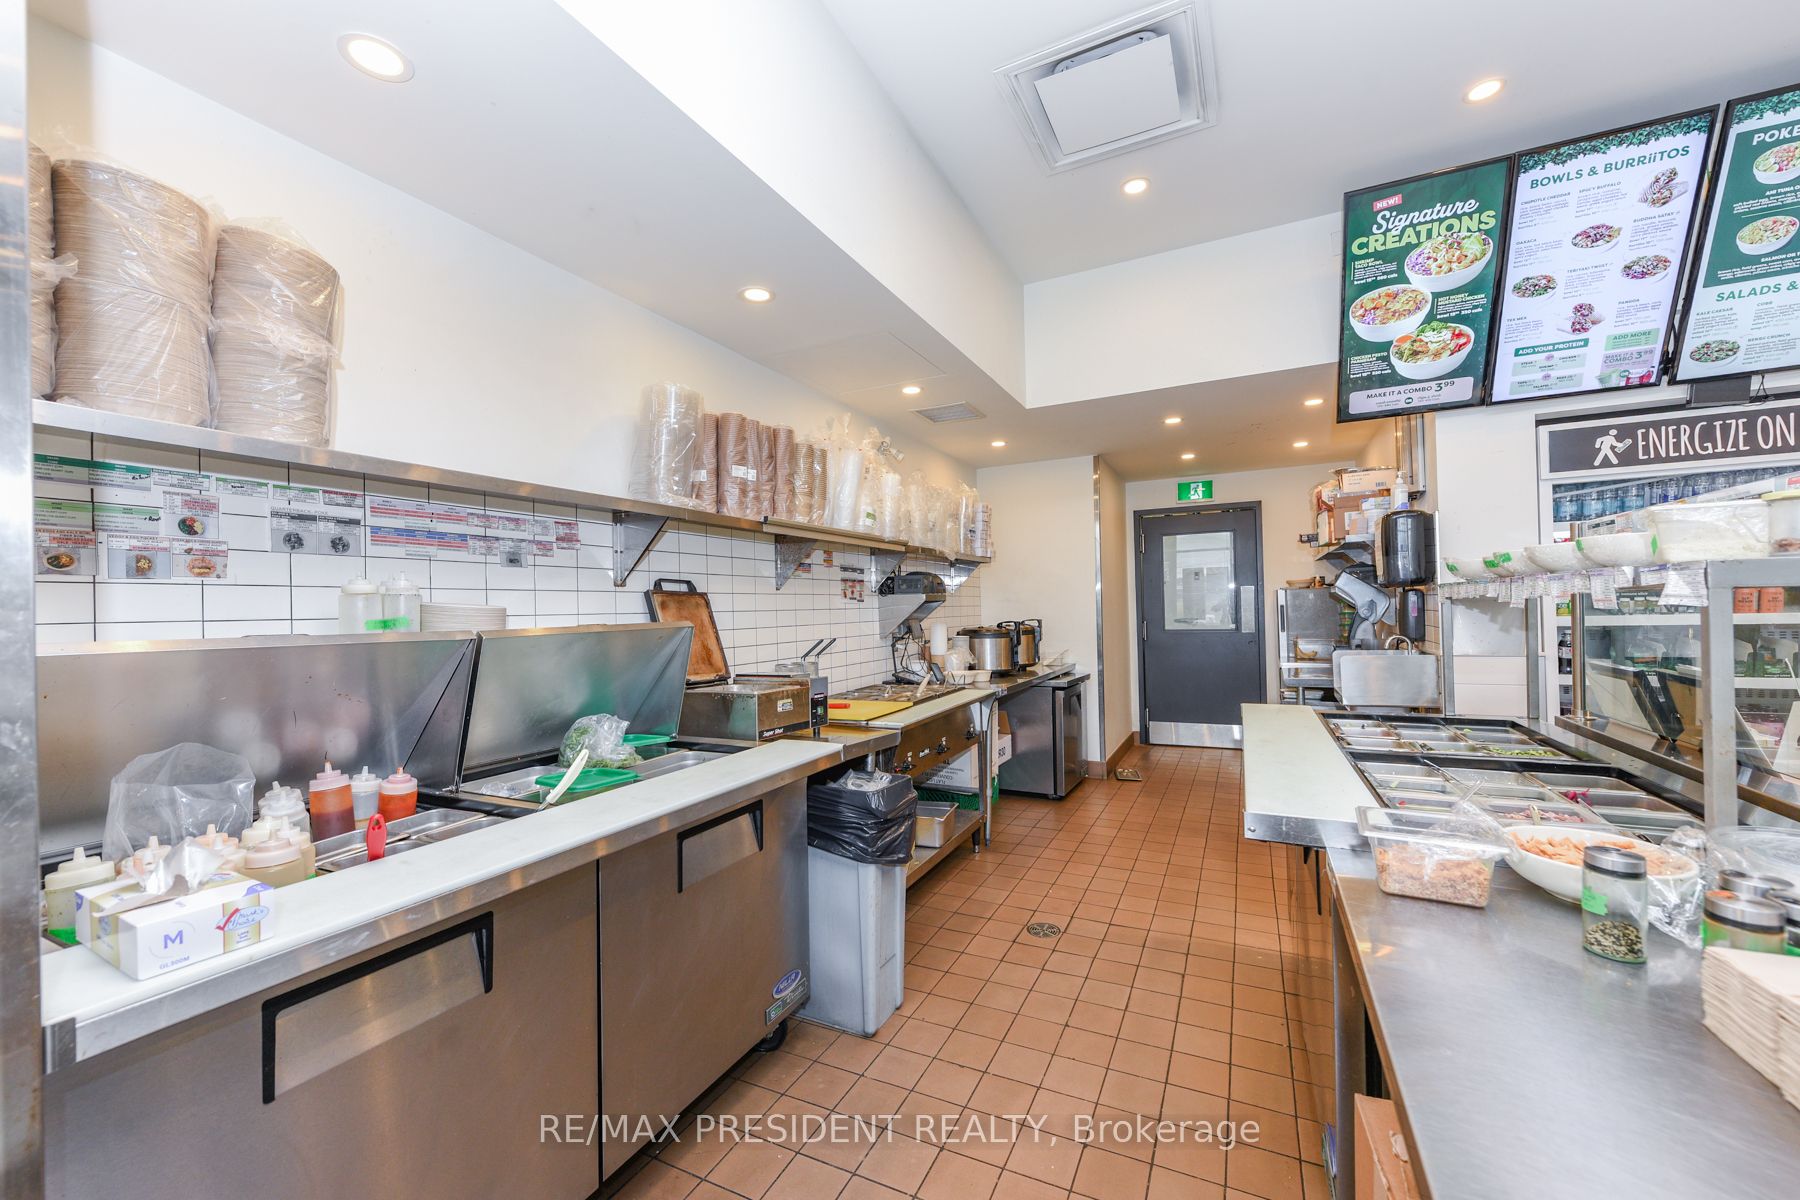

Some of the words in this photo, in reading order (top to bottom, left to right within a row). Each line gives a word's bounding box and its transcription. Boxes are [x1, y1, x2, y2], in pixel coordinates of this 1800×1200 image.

[1530, 170, 1584, 190] BOWLS
[1587, 166, 1599, 178] &
[1603, 146, 1690, 174] BURRiiTOS
[1377, 197, 1398, 208] NEW!
[1372, 199, 1479, 234] Signature
[1352, 210, 1496, 255] CREATIONS
[1716, 283, 1782, 302] SALADS
[1786, 280, 1798, 290] &
[1555, 341, 1584, 349] PROTEIN
[1404, 386, 1432, 394] COMBO
[1637, 418, 1751, 460] ENERGIZE
[1757, 412, 1795, 450] ON
[164, 930, 184, 949] M
